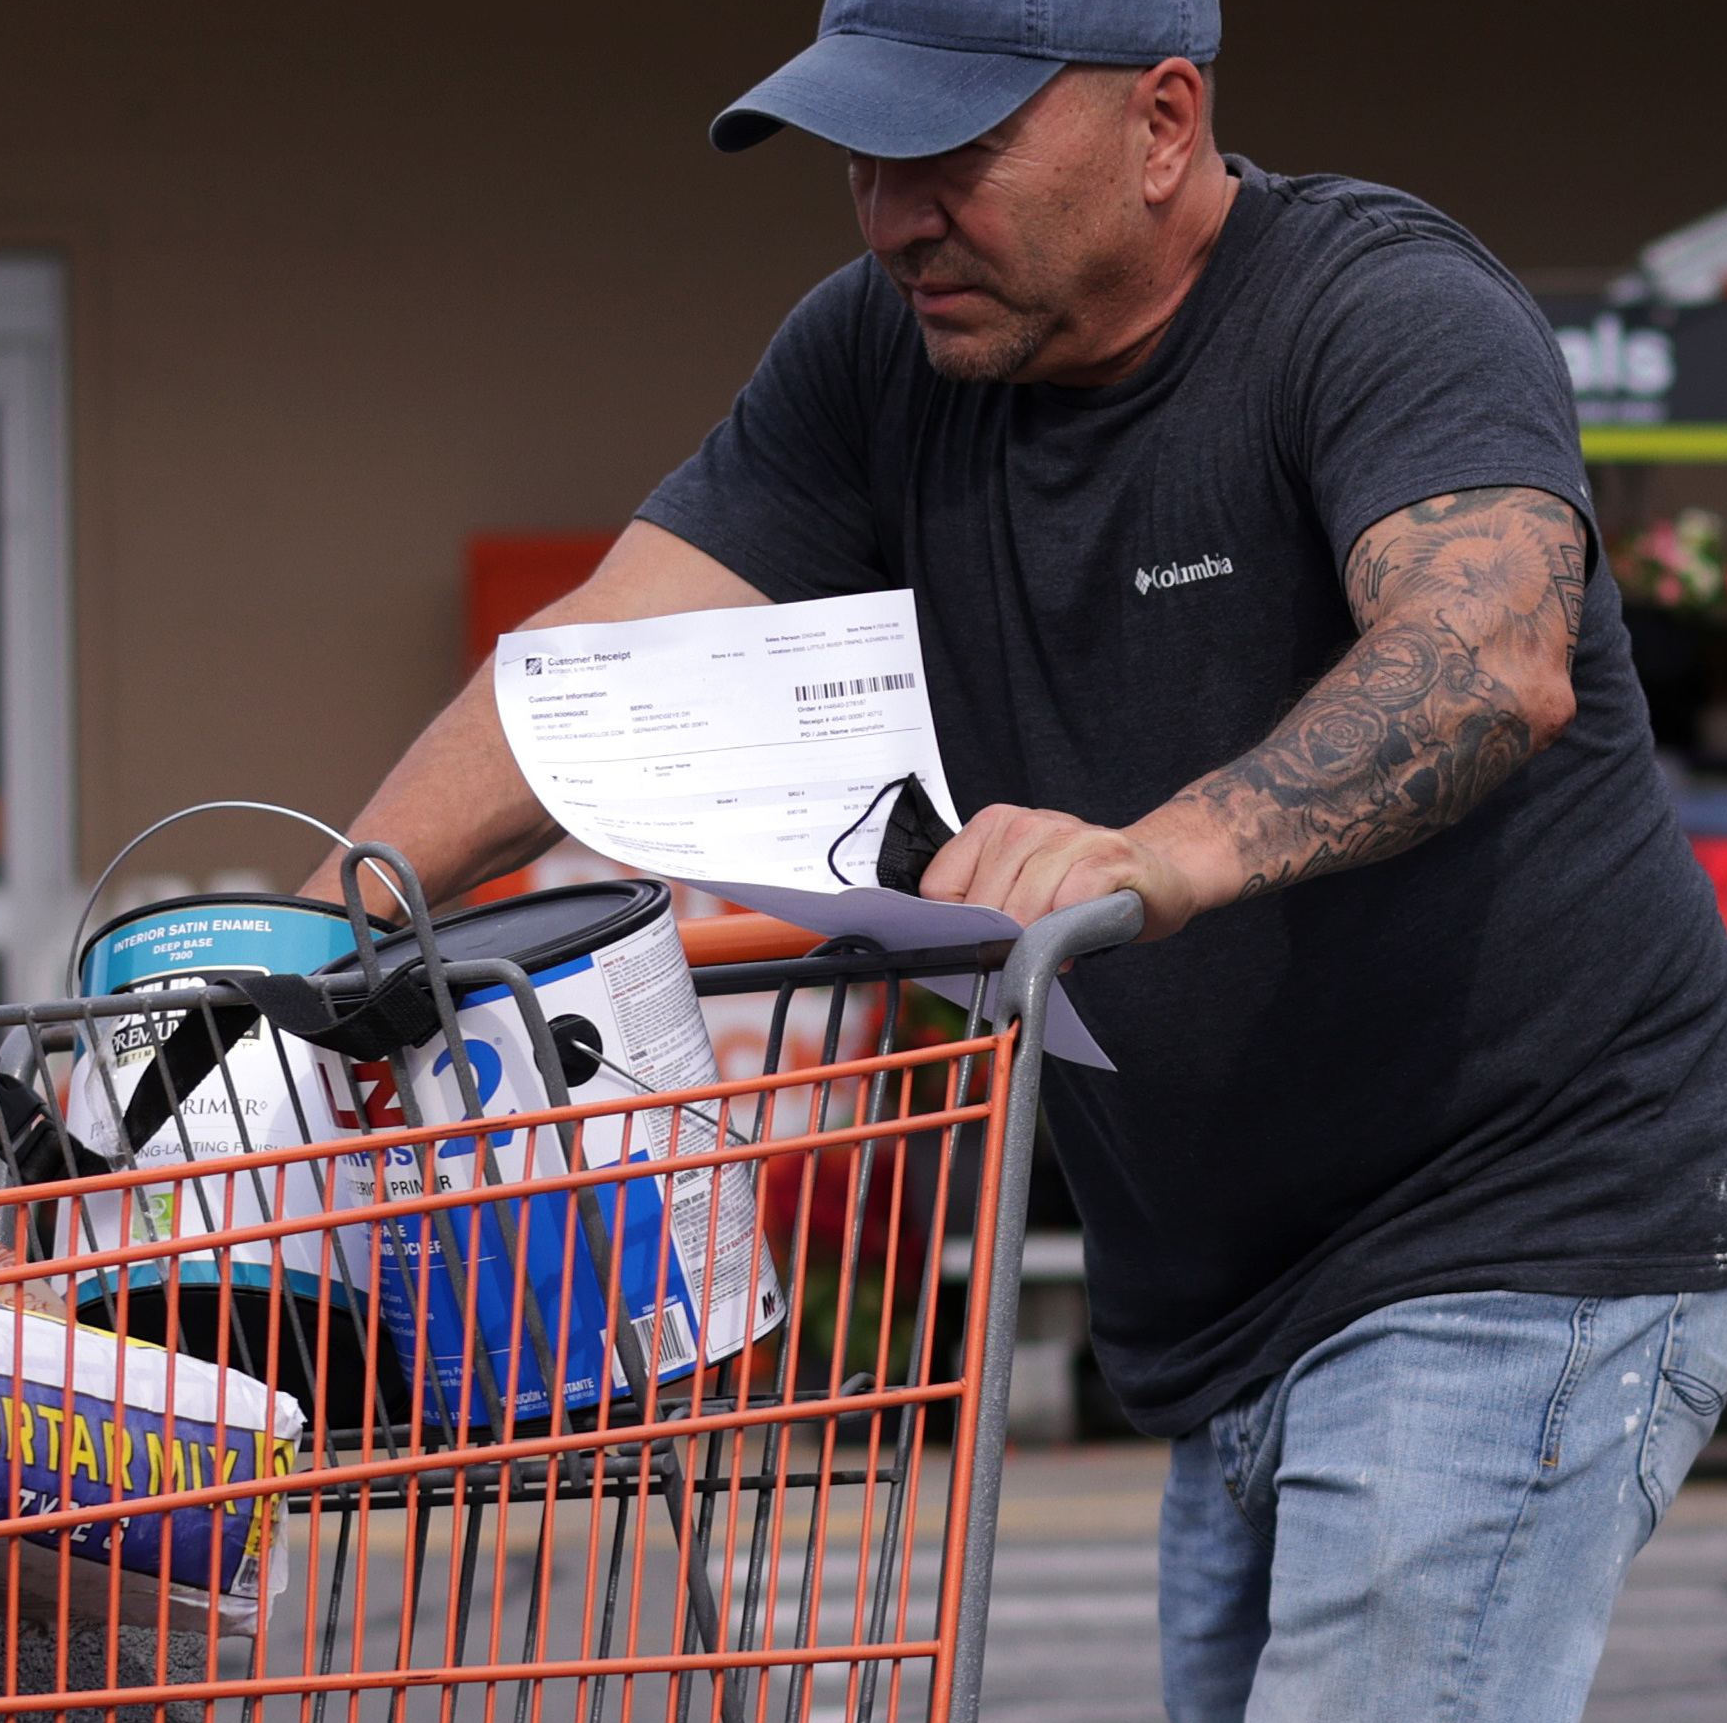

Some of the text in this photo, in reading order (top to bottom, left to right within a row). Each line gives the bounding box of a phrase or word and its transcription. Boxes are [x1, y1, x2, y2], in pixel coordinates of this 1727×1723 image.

[1152, 553, 1233, 589] Columbia
[781, 634, 801, 642] Person
[547, 651, 632, 667] Customer Receipt
[528, 691, 608, 704] Customer Information
[798, 705, 816, 713] Order
[799, 716, 825, 727] Receipt
[815, 729, 829, 738] Job
[113, 919, 273, 954] INTERIOR SATIN ENAMEL
[153, 937, 214, 955] DEEP BASE
[169, 950, 194, 962] 7300
[390, 1174, 452, 1196] PRIMR
[146, 1431, 239, 1515] MIX
